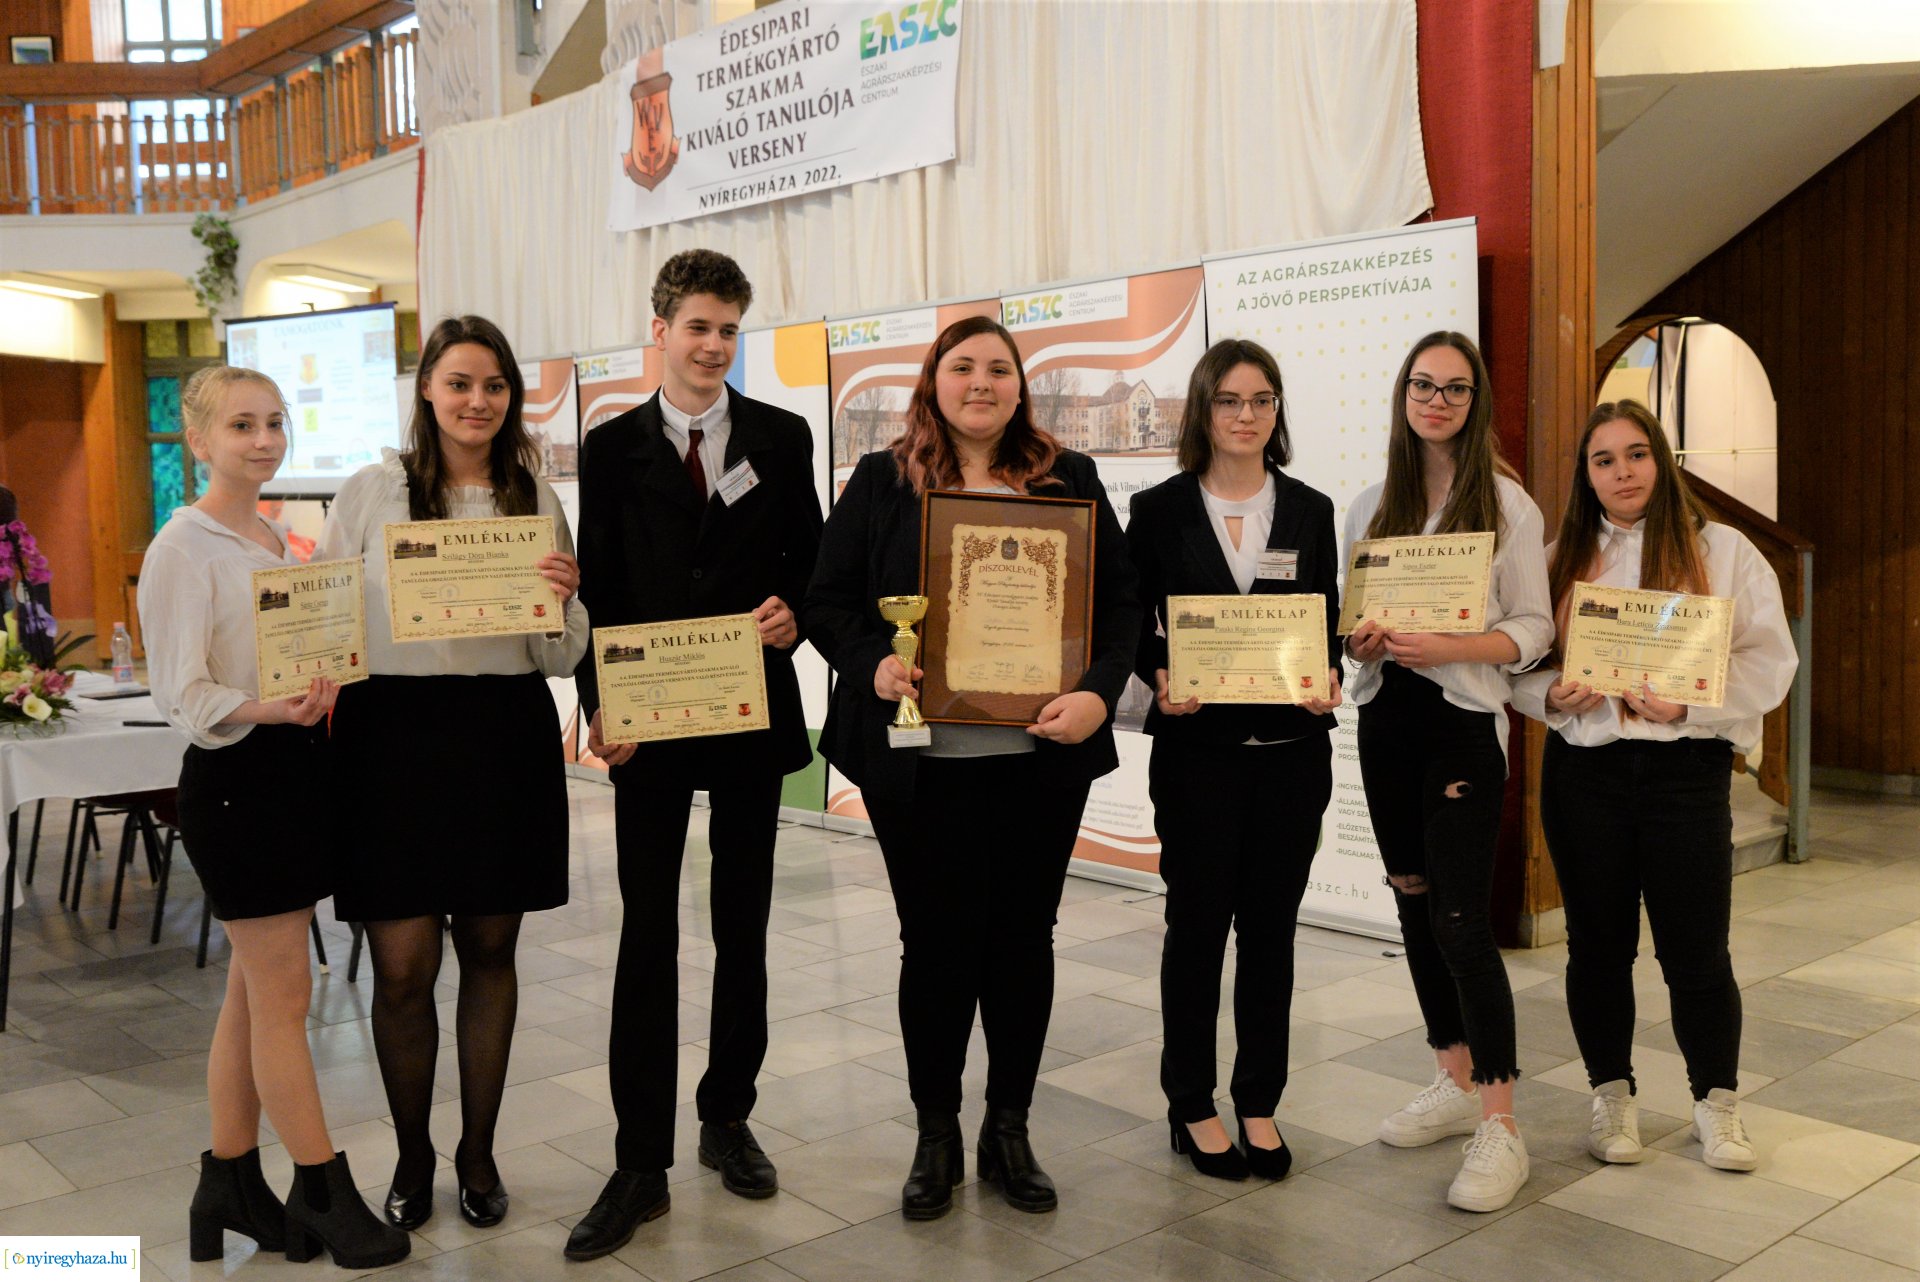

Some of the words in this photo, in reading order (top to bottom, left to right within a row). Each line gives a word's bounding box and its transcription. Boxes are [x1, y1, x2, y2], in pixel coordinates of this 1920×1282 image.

[719, 7, 810, 56] ÉDESIPARI
[860, 0, 958, 60] EASZC
[697, 24, 840, 92] TERMÉKGYÁRTÓ
[861, 62, 888, 77] ÉSZAKI
[861, 61, 942, 90] AGRÁRSZAKKÉPZÉSI
[726, 71, 804, 111] SZAKMA
[861, 86, 899, 104] CENTRUM
[686, 112, 749, 152] KIVÁLÓ
[757, 87, 855, 132] TANULÓJA
[728, 131, 807, 169] VERSENY
[699, 174, 797, 209] NYÍREGYHÁZA
[804, 164, 842, 186] 2022.
[1237, 271, 1257, 286] AZ
[1262, 247, 1433, 283] AGRÁRSZAKKÉPZÉS
[1237, 298, 1247, 311] A
[1251, 289, 1294, 310] JÖVŐ
[1299, 276, 1432, 305] PERSPEKTÍVÁJA
[1004, 293, 1063, 326] EASZC
[830, 319, 881, 348] EASZC
[443, 530, 537, 546] EMLÉKLAP
[1395, 545, 1477, 558] EMLÉKLAP
[293, 575, 352, 594] EMLÉKLAP
[978, 563, 1039, 578] DÍSZOKLEVÉL
[1220, 607, 1308, 619] EMLÉKLAP
[1625, 601, 1713, 619] EMLÉKLAP
[650, 630, 742, 648] EMLÉKLAP
[1306, 881, 1369, 899] aszc.hu
